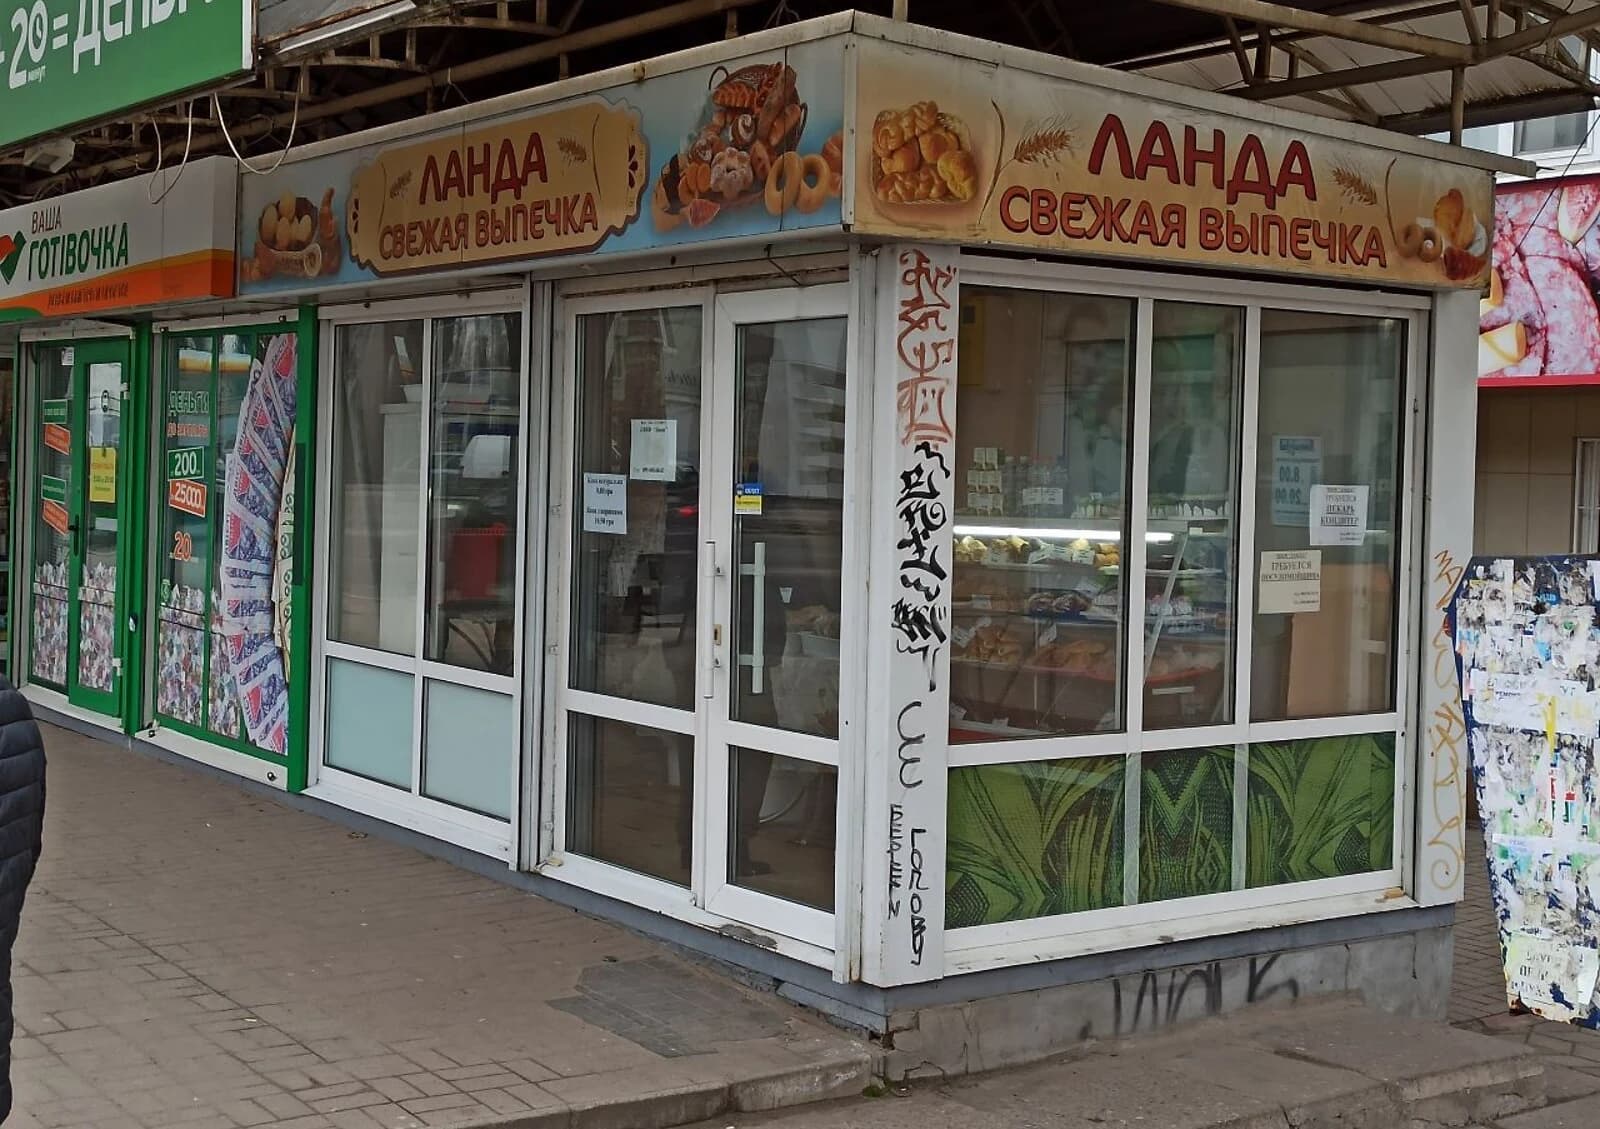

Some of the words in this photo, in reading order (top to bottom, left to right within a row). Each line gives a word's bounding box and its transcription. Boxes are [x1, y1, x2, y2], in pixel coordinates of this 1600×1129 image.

[419, 132, 548, 205] ЛАНДА
[1088, 113, 1317, 210] ЛАНДА
[28, 222, 129, 281] ГОТІВОЧКА
[31, 205, 62, 235] ВАША
[379, 213, 469, 260] СВЕЖАЯ
[475, 192, 598, 248] ВЫПЕЧКА
[1000, 185, 1188, 249] СВЕЖАЯ
[1199, 207, 1387, 268] ВЫПЕЧКА
[174, 452, 197, 476] 200
[174, 531, 191, 562] 20
